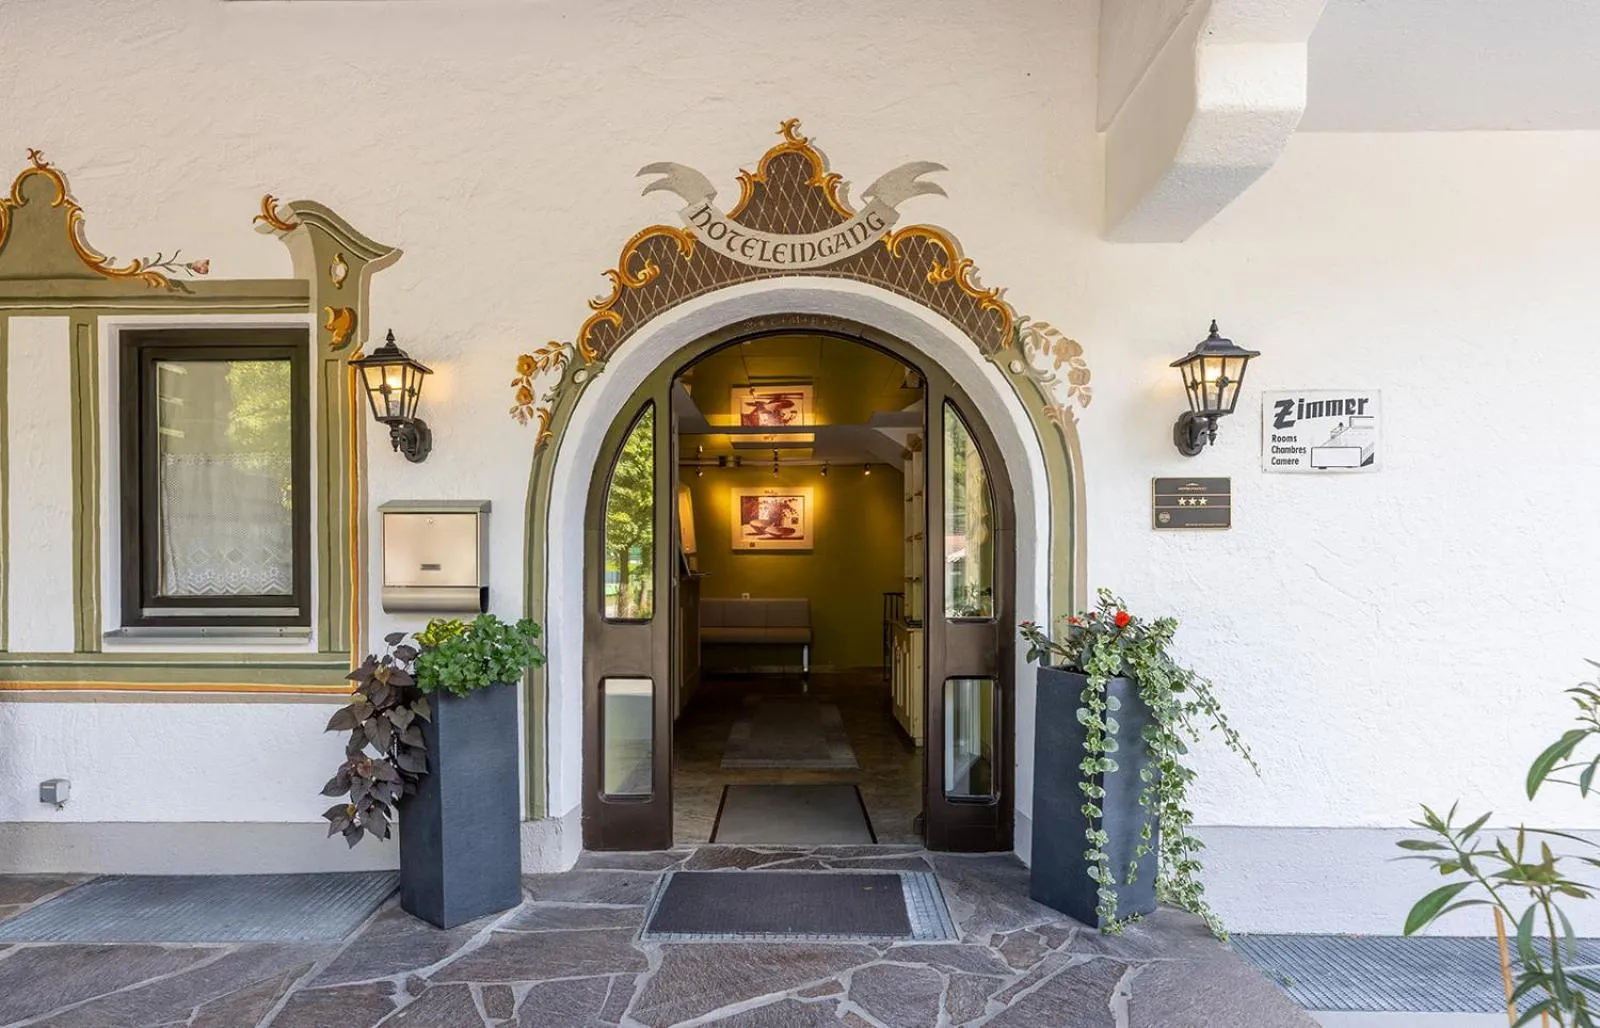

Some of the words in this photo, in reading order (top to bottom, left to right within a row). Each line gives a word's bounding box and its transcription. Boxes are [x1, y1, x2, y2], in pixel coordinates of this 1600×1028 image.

[689, 204, 886, 264] HOTELEINGANG
[1272, 398, 1369, 430] Zimmer
[1272, 434, 1297, 443] Rooms
[1271, 445, 1307, 454] Chambres
[1271, 457, 1300, 466] Camere
